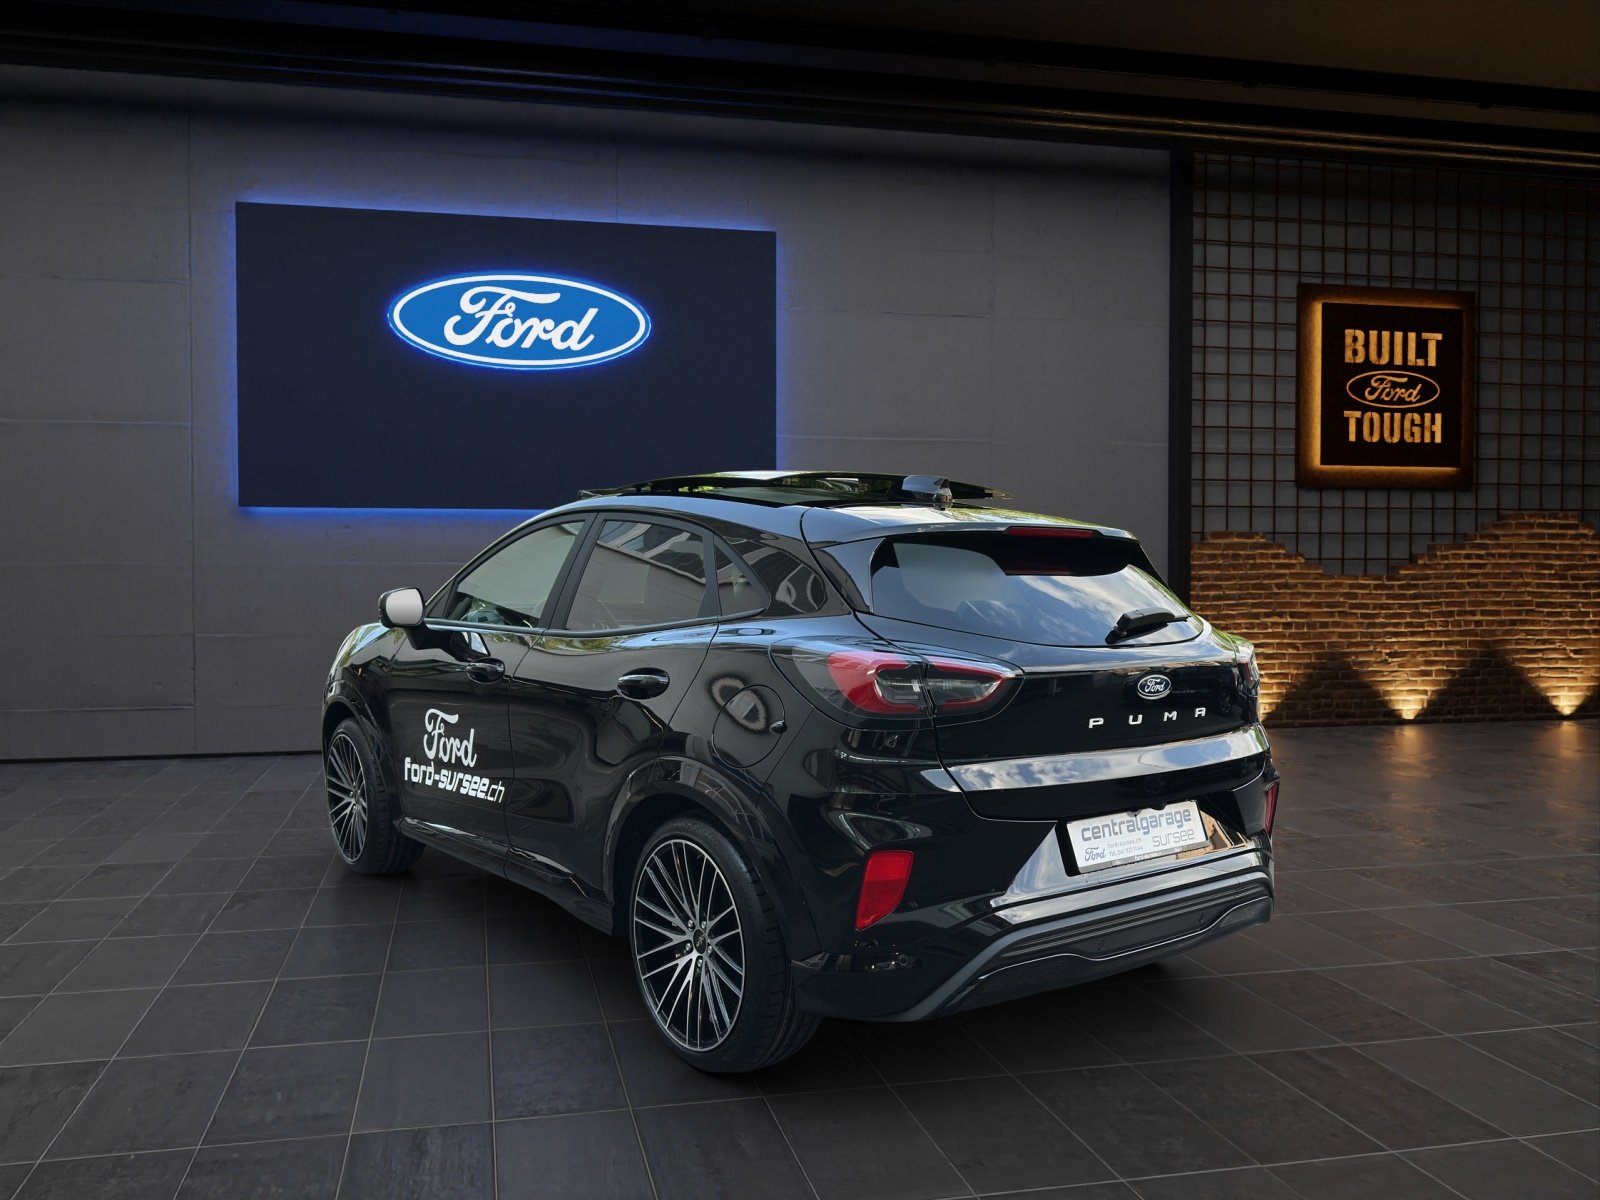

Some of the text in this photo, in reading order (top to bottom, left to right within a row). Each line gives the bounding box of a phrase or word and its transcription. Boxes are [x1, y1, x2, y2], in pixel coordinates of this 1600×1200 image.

[444, 285, 599, 351] Ford
[1344, 328, 1443, 367] BUILT
[1364, 374, 1423, 403] Ford
[1343, 410, 1442, 444] TOUGH
[1145, 678, 1166, 693] Ford
[1088, 707, 1206, 728] PUMA
[423, 708, 478, 768] Ford
[404, 757, 505, 803] ford-sursee.ch
[1081, 808, 1192, 842] centralgarage
[1152, 828, 1196, 848] sursee
[1085, 846, 1107, 861] Ford
